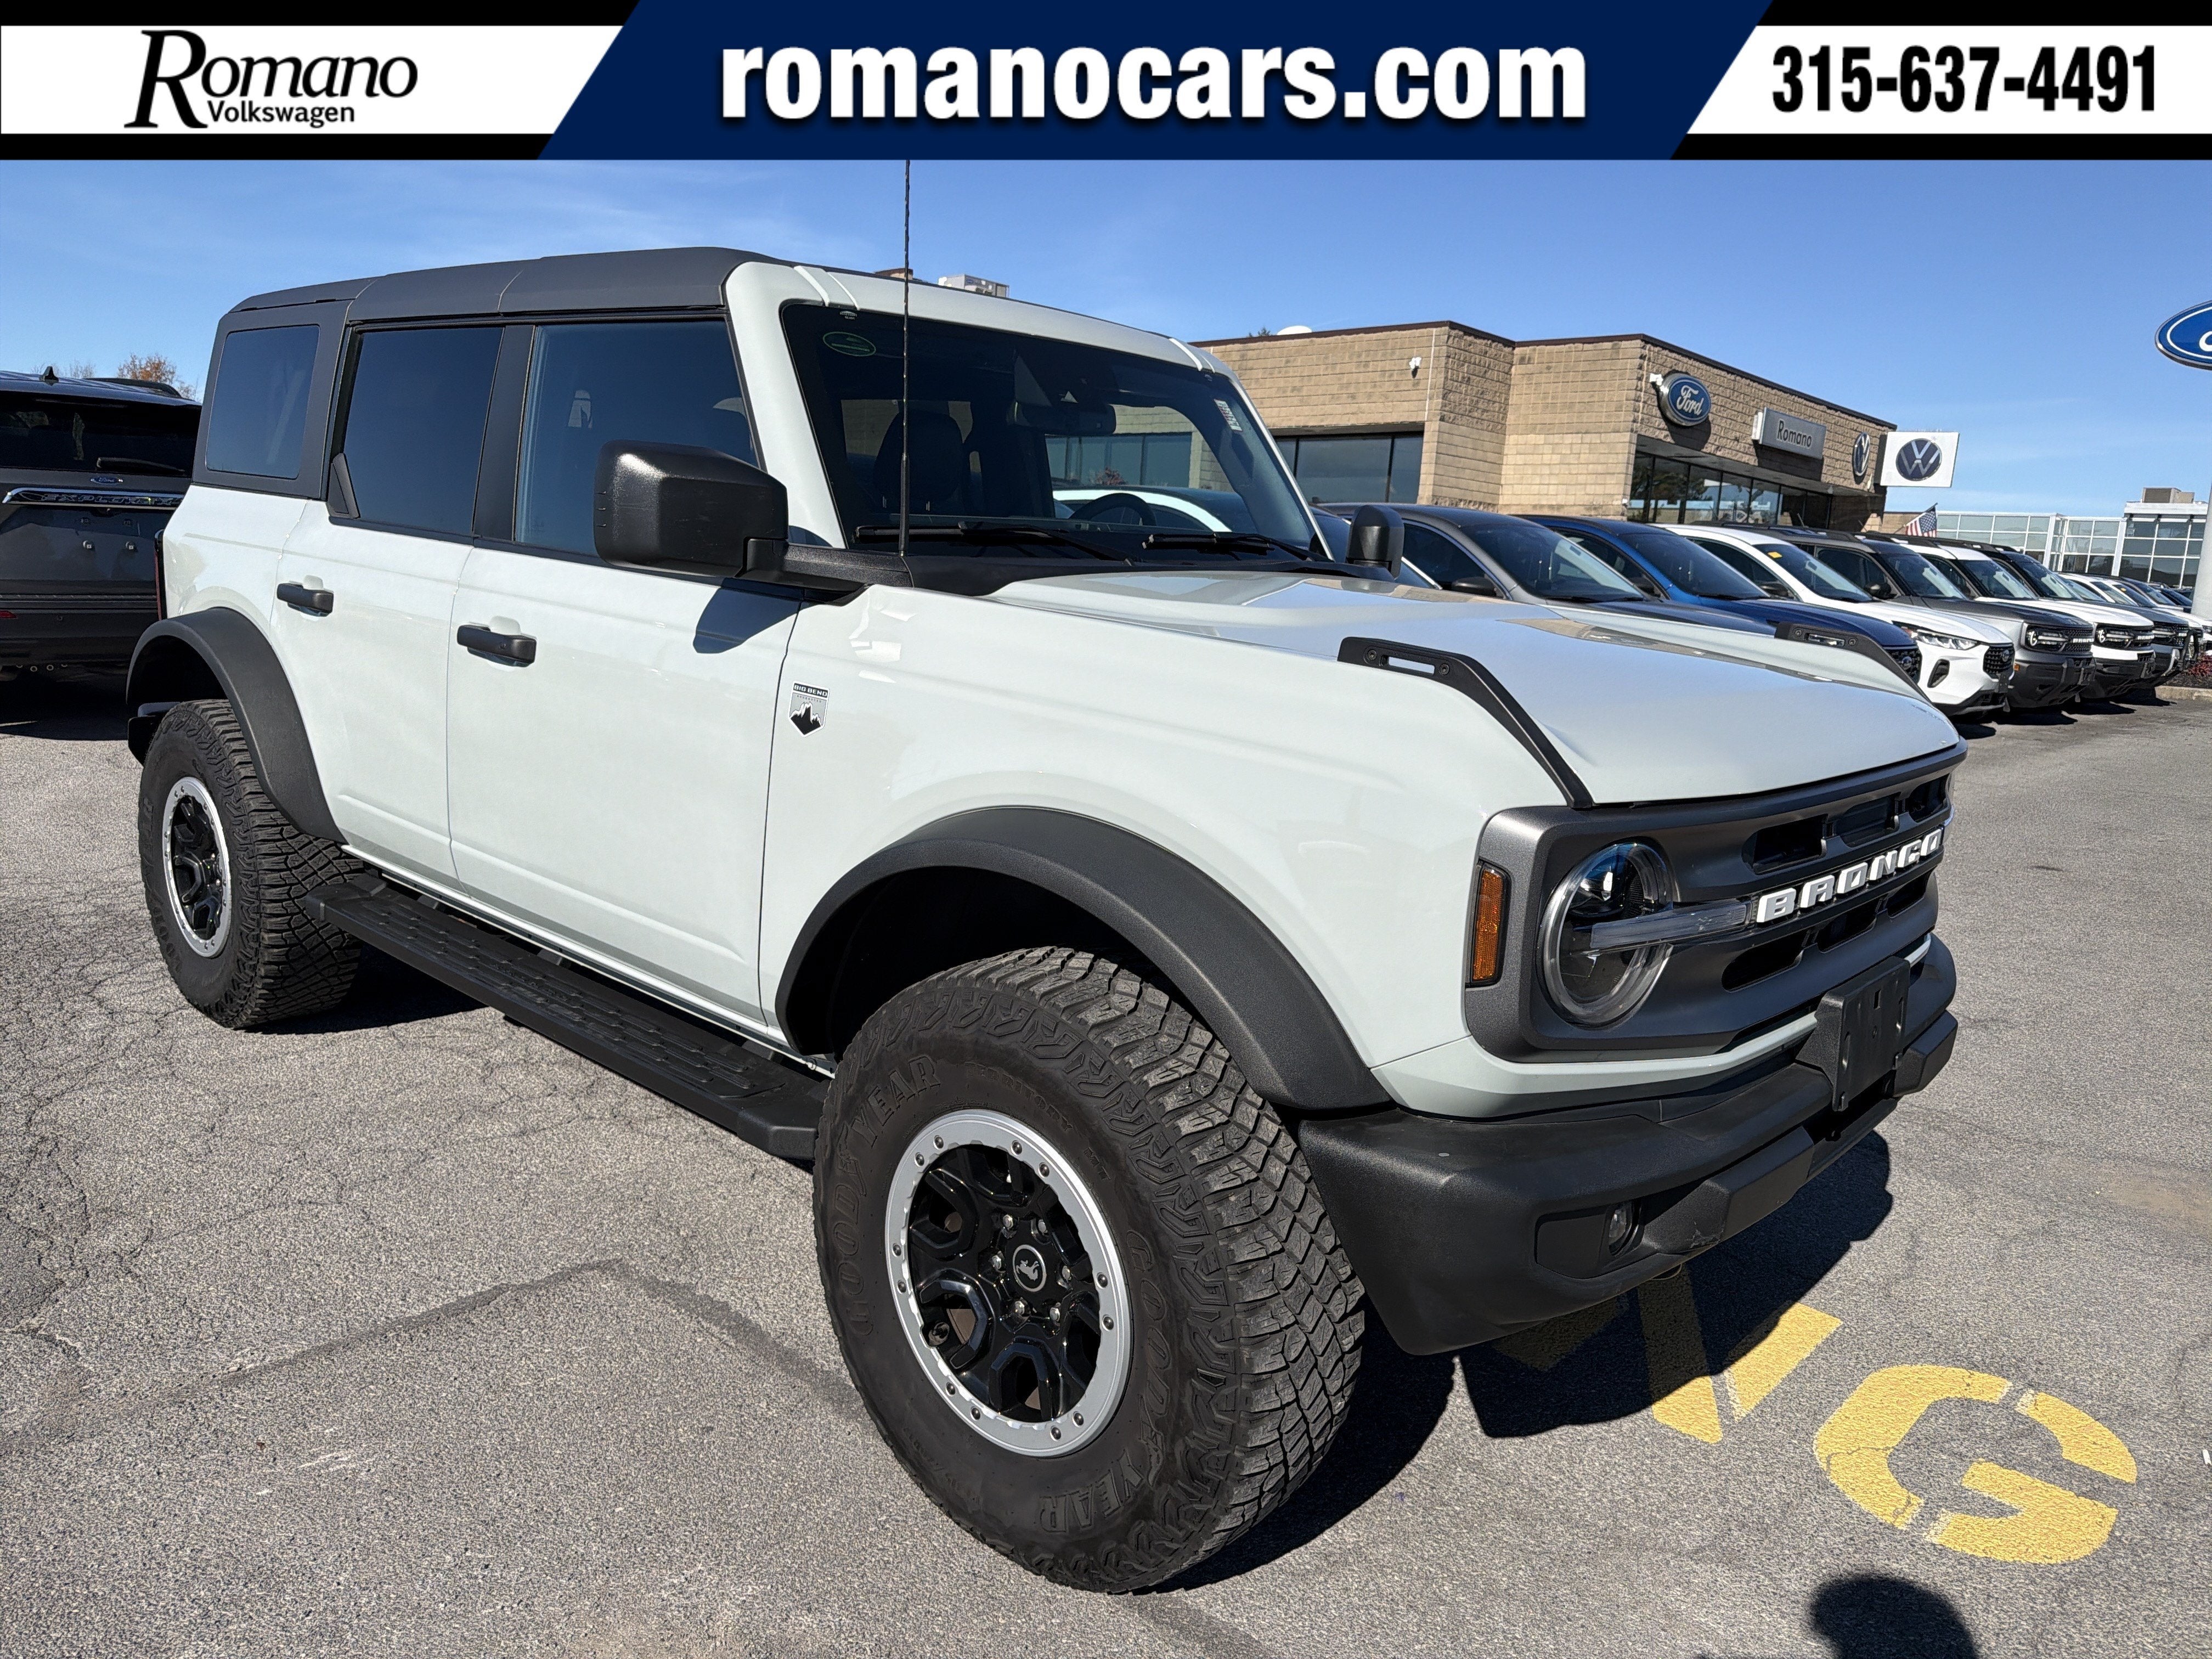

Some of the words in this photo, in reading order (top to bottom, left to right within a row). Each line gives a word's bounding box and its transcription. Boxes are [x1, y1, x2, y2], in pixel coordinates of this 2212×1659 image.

[1676, 385, 1705, 416] Ford
[1777, 419, 1812, 448] Romano
[807, 688, 828, 697] BEND
[1756, 828, 1942, 923] BRONCO
